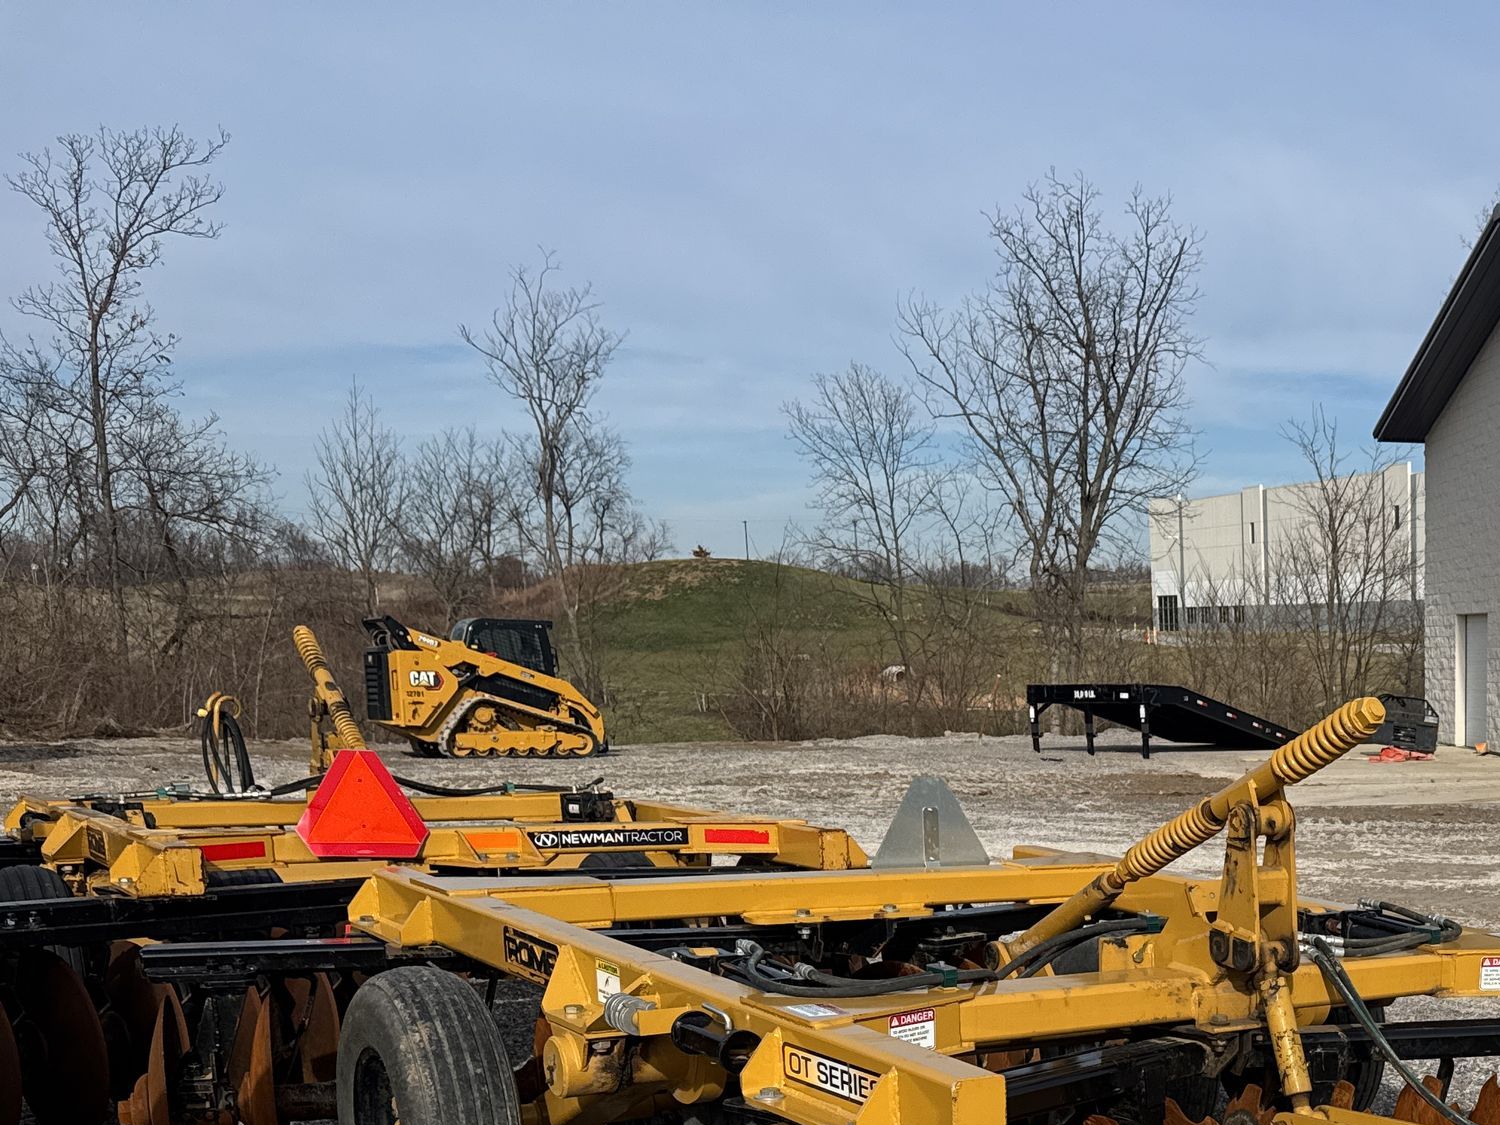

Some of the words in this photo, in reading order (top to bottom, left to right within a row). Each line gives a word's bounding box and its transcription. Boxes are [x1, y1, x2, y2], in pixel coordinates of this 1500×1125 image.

[409, 671, 436, 687] CAT
[562, 830, 683, 845] NEWMANTRACTOR
[900, 1010, 934, 1025] DANGER
[789, 1052, 812, 1079] OT
